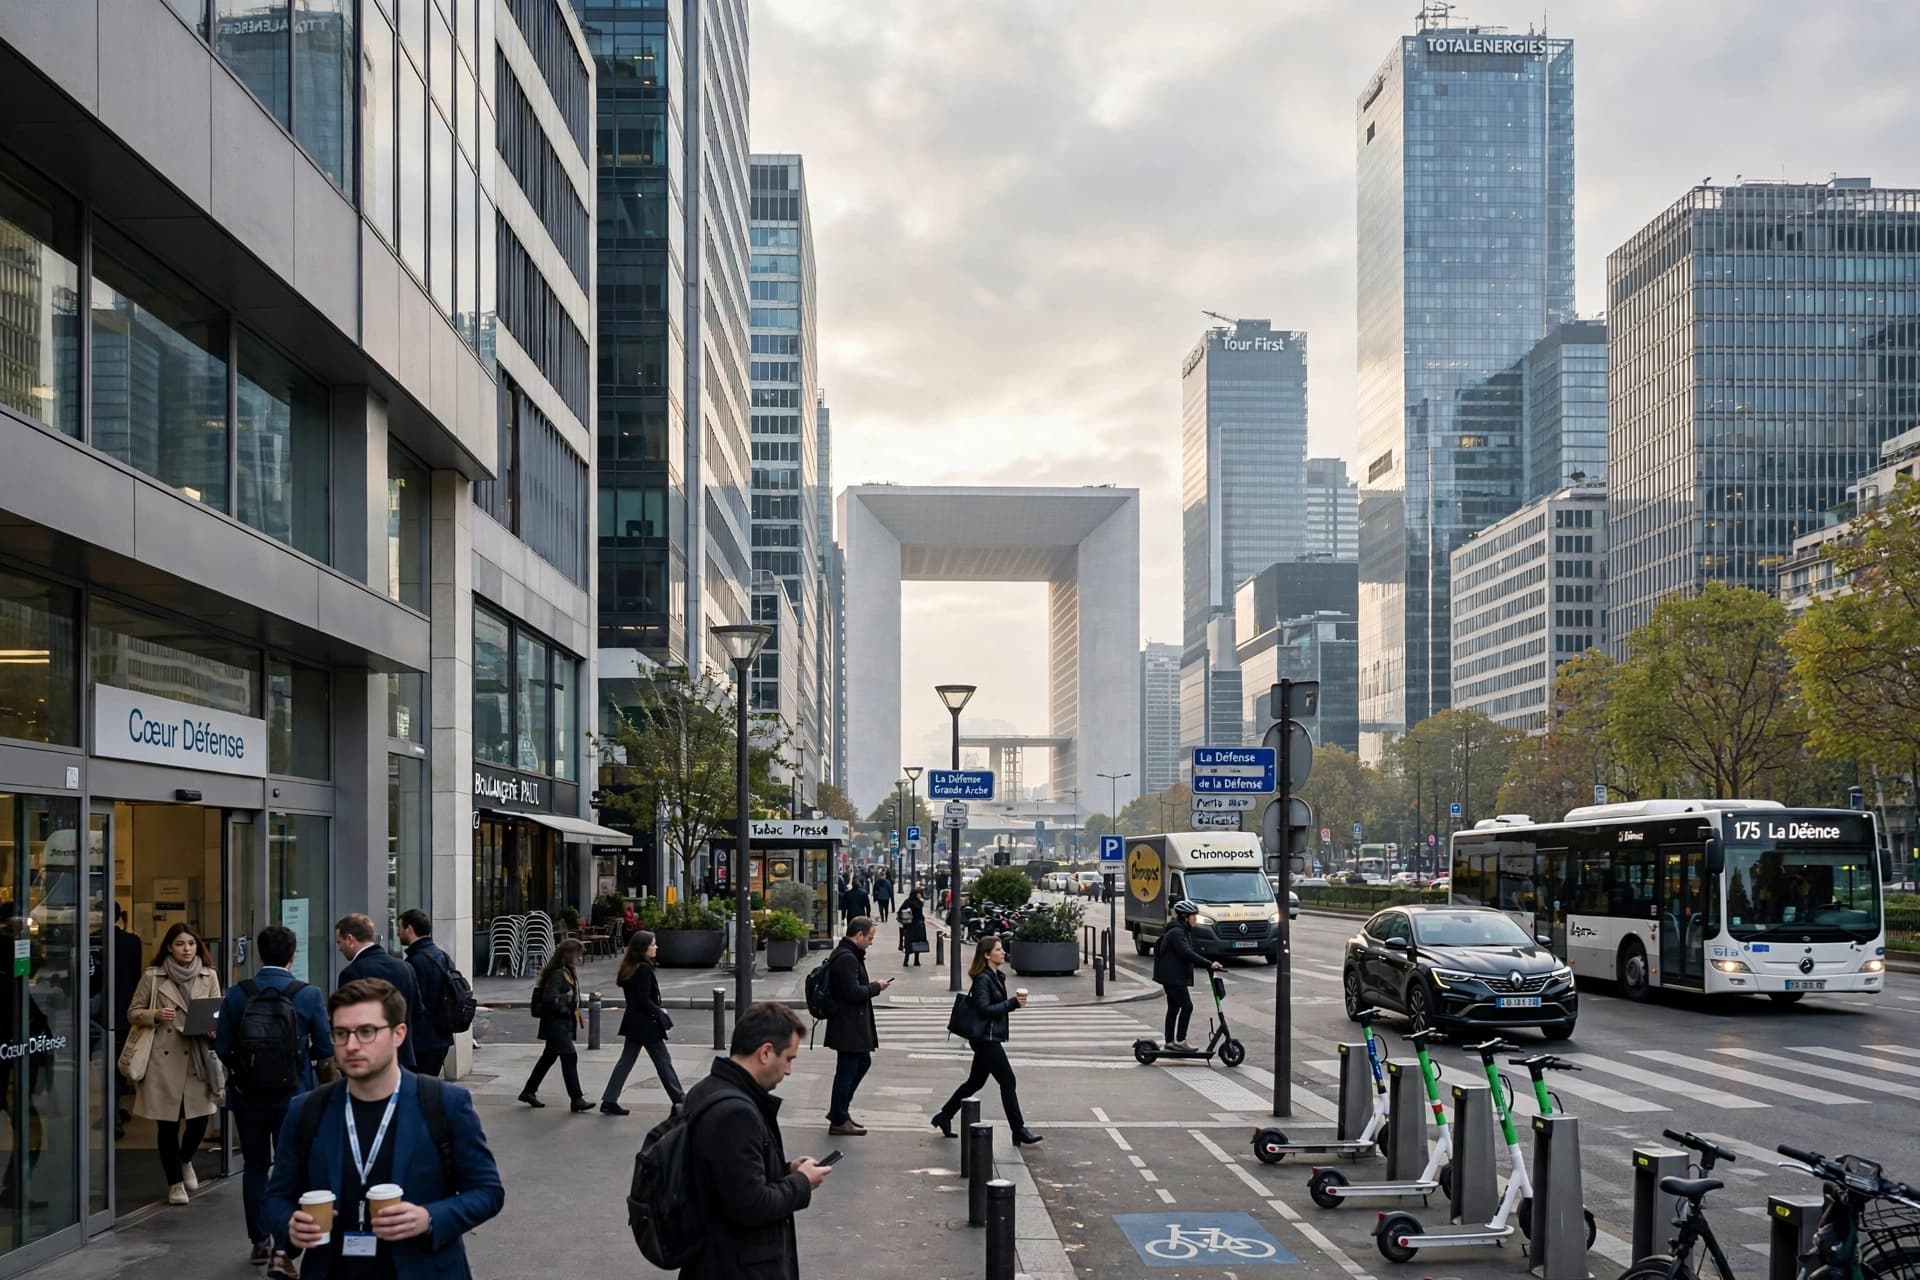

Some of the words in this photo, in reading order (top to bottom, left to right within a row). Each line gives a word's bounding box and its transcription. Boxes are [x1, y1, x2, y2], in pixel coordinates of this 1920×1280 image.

[1427, 39, 1546, 54] TOTALENERGIES
[1222, 337, 1252, 351] Tour
[1255, 337, 1285, 351] First
[129, 708, 178, 748] Cœur
[183, 719, 244, 759] Défense
[1200, 752, 1212, 762] La
[1216, 751, 1256, 763] Défense
[935, 774, 946, 783] La
[1199, 778, 1210, 788] de
[1213, 777, 1222, 789] la
[1224, 777, 1263, 789] Défense
[965, 785, 989, 795] Arche
[752, 823, 783, 836] Tabac
[793, 824, 828, 838] Presse
[1734, 821, 1760, 840] 175
[1768, 822, 1786, 839] La
[1106, 838, 1119, 857] P
[1191, 849, 1255, 861] Chronopost
